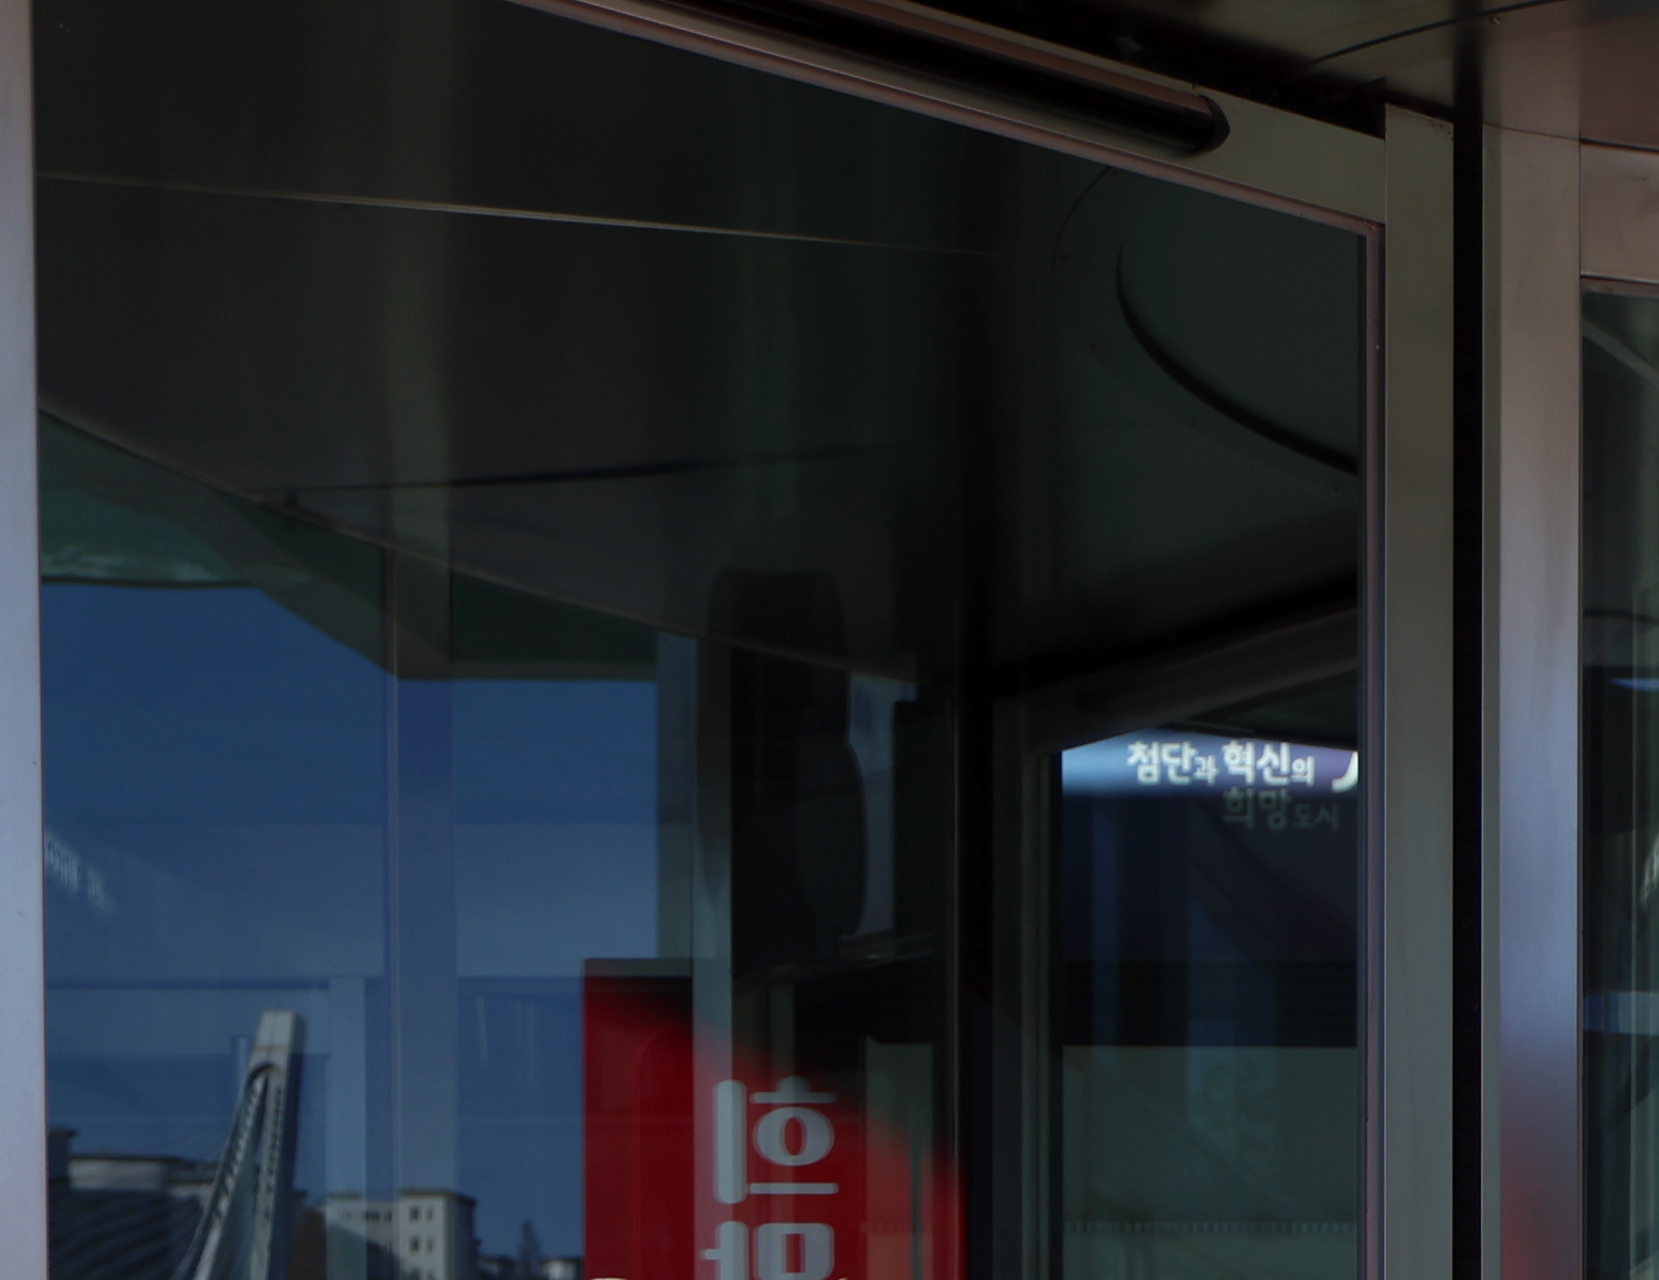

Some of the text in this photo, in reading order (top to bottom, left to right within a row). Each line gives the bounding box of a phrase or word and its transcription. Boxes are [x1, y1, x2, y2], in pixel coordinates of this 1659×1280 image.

[1126, 740, 1218, 786] 첨단과
[1222, 739, 1315, 788] 혁신의
[1222, 787, 1340, 831] 희망도시
